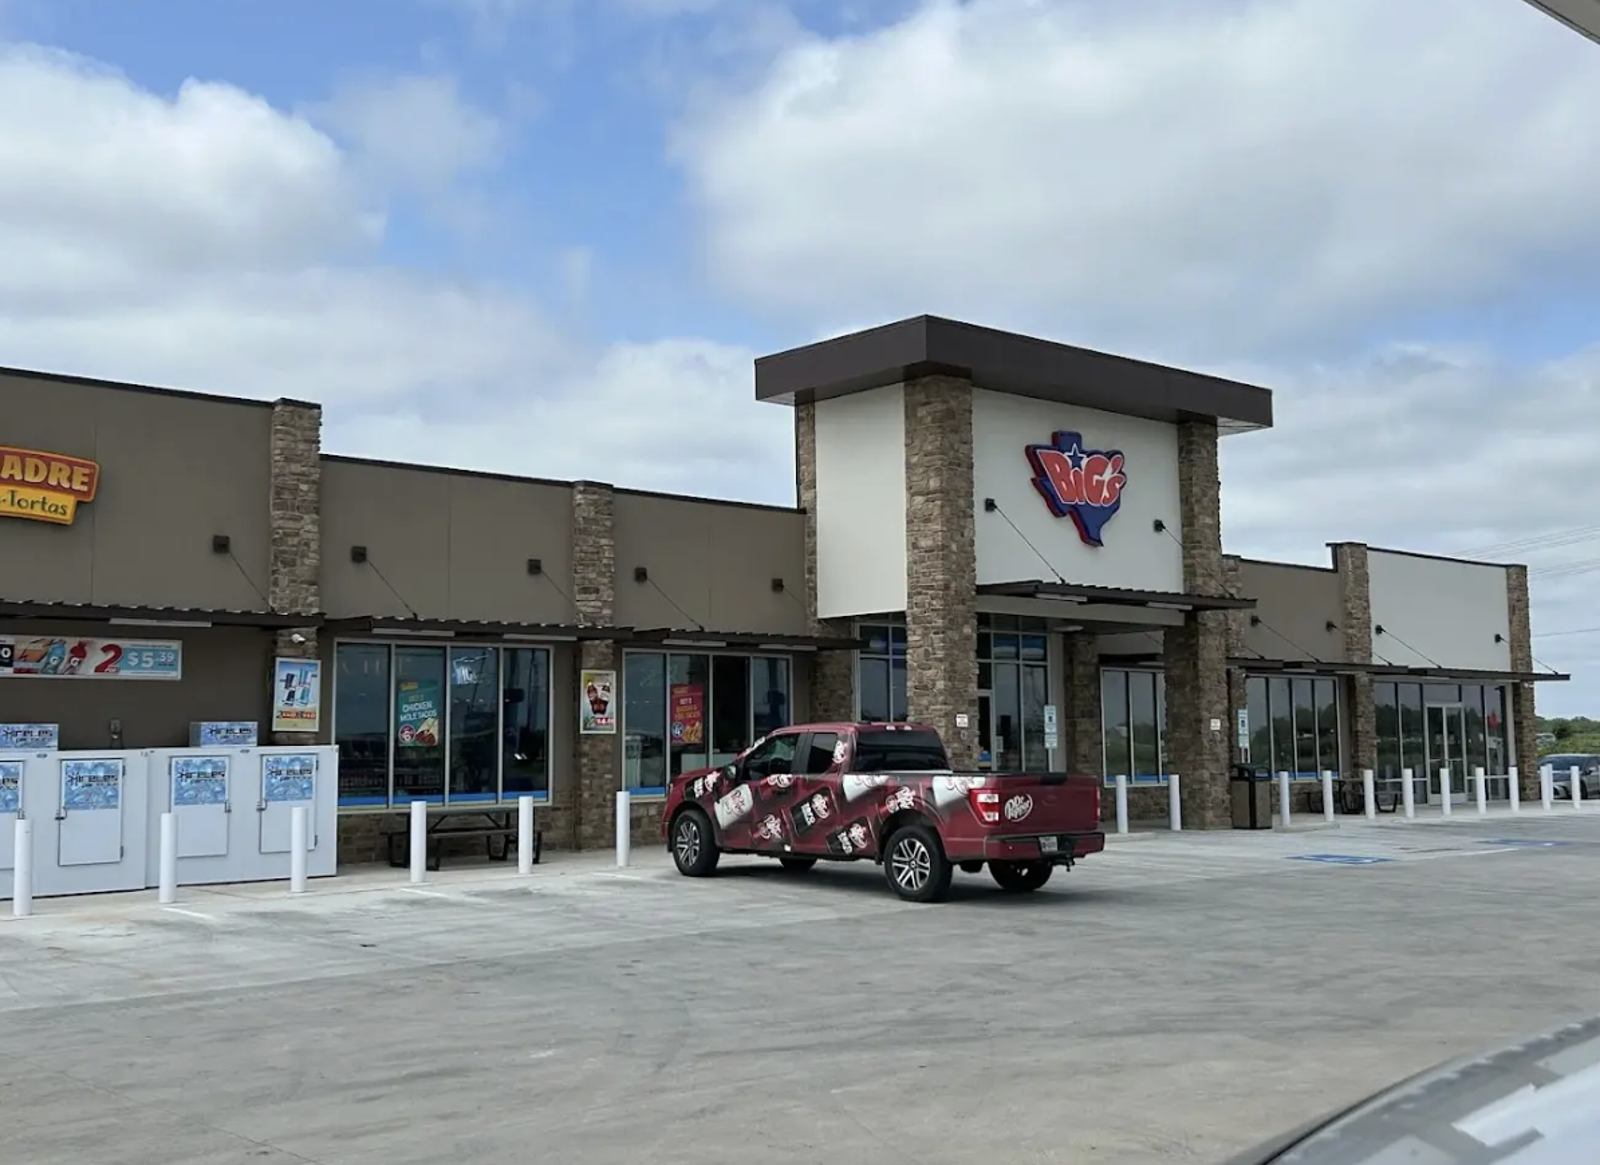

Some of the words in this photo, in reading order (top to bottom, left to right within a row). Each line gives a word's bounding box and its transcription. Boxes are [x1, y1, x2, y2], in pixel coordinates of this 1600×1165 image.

[0, 455, 90, 492] ADRE
[8, 490, 68, 516] Tortas
[94, 643, 123, 673] 2
[402, 701, 433, 713] CHICKEN
